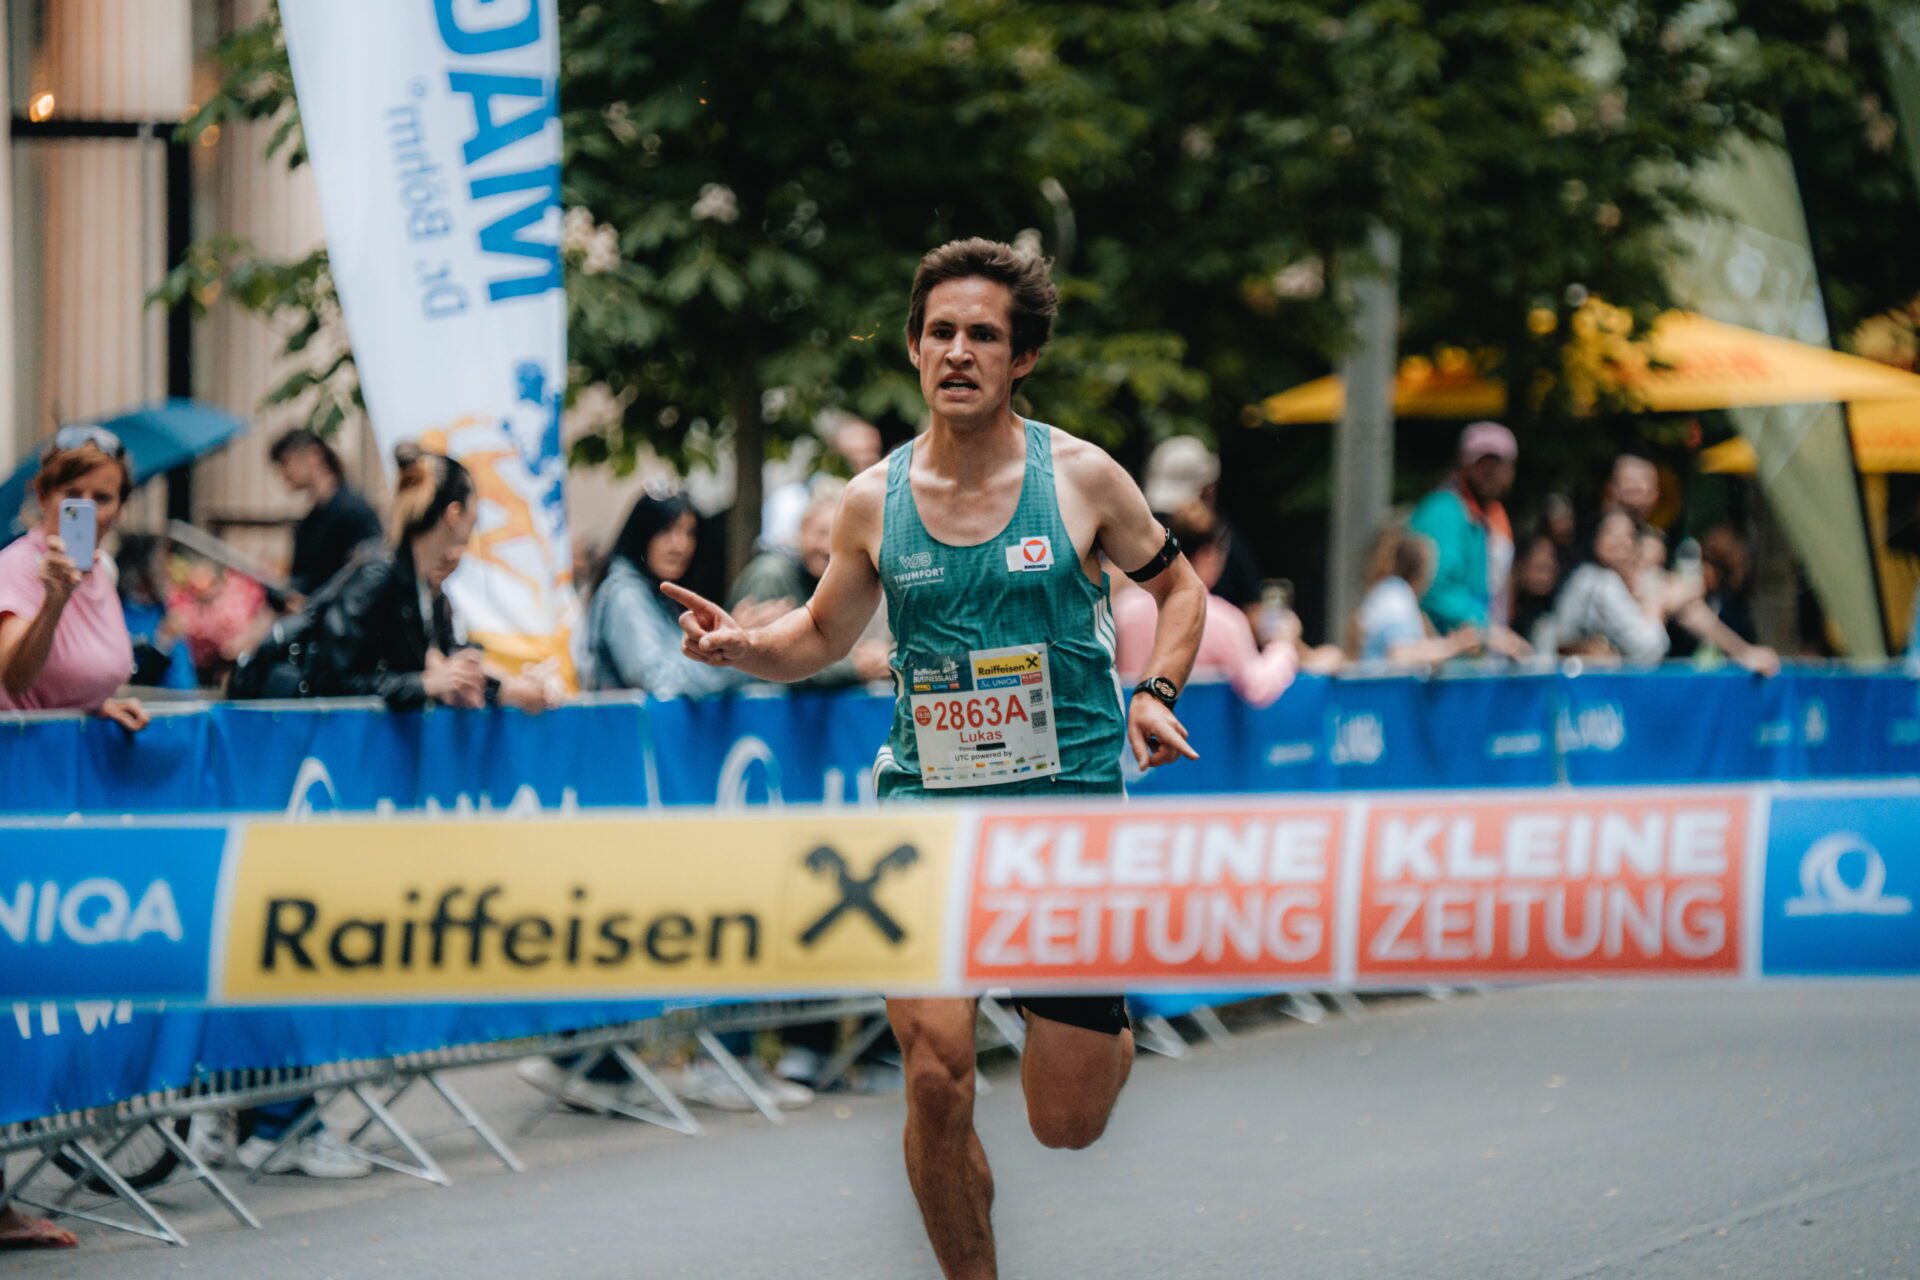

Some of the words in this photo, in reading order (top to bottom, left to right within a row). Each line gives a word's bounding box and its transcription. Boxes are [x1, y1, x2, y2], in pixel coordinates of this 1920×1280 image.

[894, 567, 945, 584] THUMFORT
[977, 664, 1025, 676] Raiffeisen
[992, 678, 1018, 686] UNIQA
[933, 694, 1029, 731] 2863A
[959, 729, 1002, 744] Lukas
[971, 752, 1001, 761] powered
[1003, 750, 1013, 758] by
[986, 813, 1329, 888] KLEINE
[1378, 808, 1731, 881] KLEINE
[261, 884, 761, 974] Raiffeisen
[974, 886, 1325, 966] ZEITUNG
[1368, 880, 1728, 961] ZEITUNG
